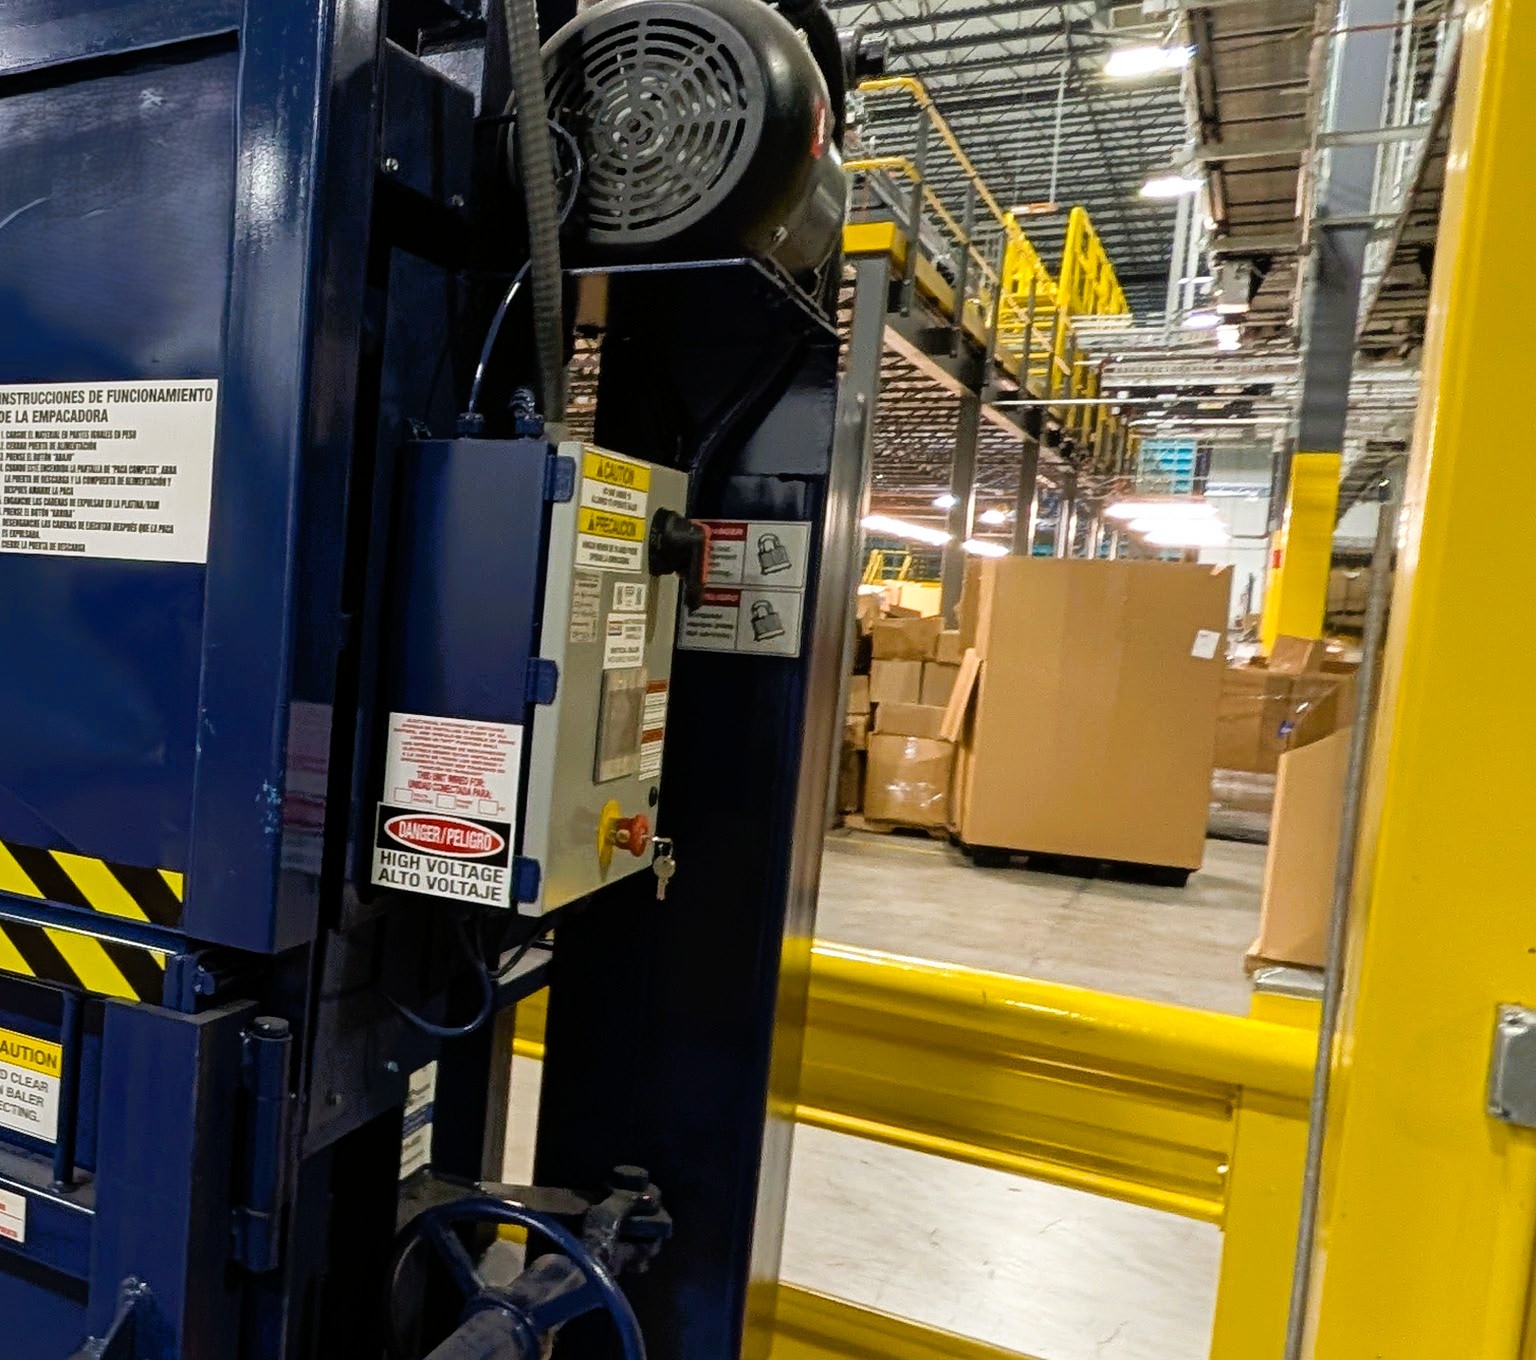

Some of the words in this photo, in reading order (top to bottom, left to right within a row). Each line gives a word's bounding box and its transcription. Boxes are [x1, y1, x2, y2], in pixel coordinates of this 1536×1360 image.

[89, 390, 103, 403] DE
[107, 388, 213, 403] FUNCIONAMIENTO
[16, 410, 28, 423] LA
[32, 409, 108, 423] EMPACADORA
[381, 851, 420, 869] HIGH
[426, 859, 503, 884] VOLTAGE
[379, 868, 420, 887] ALTO
[426, 876, 501, 901] VOLTAJE
[11, 1072, 48, 1093] CLEAR
[6, 1087, 44, 1107] BALER
